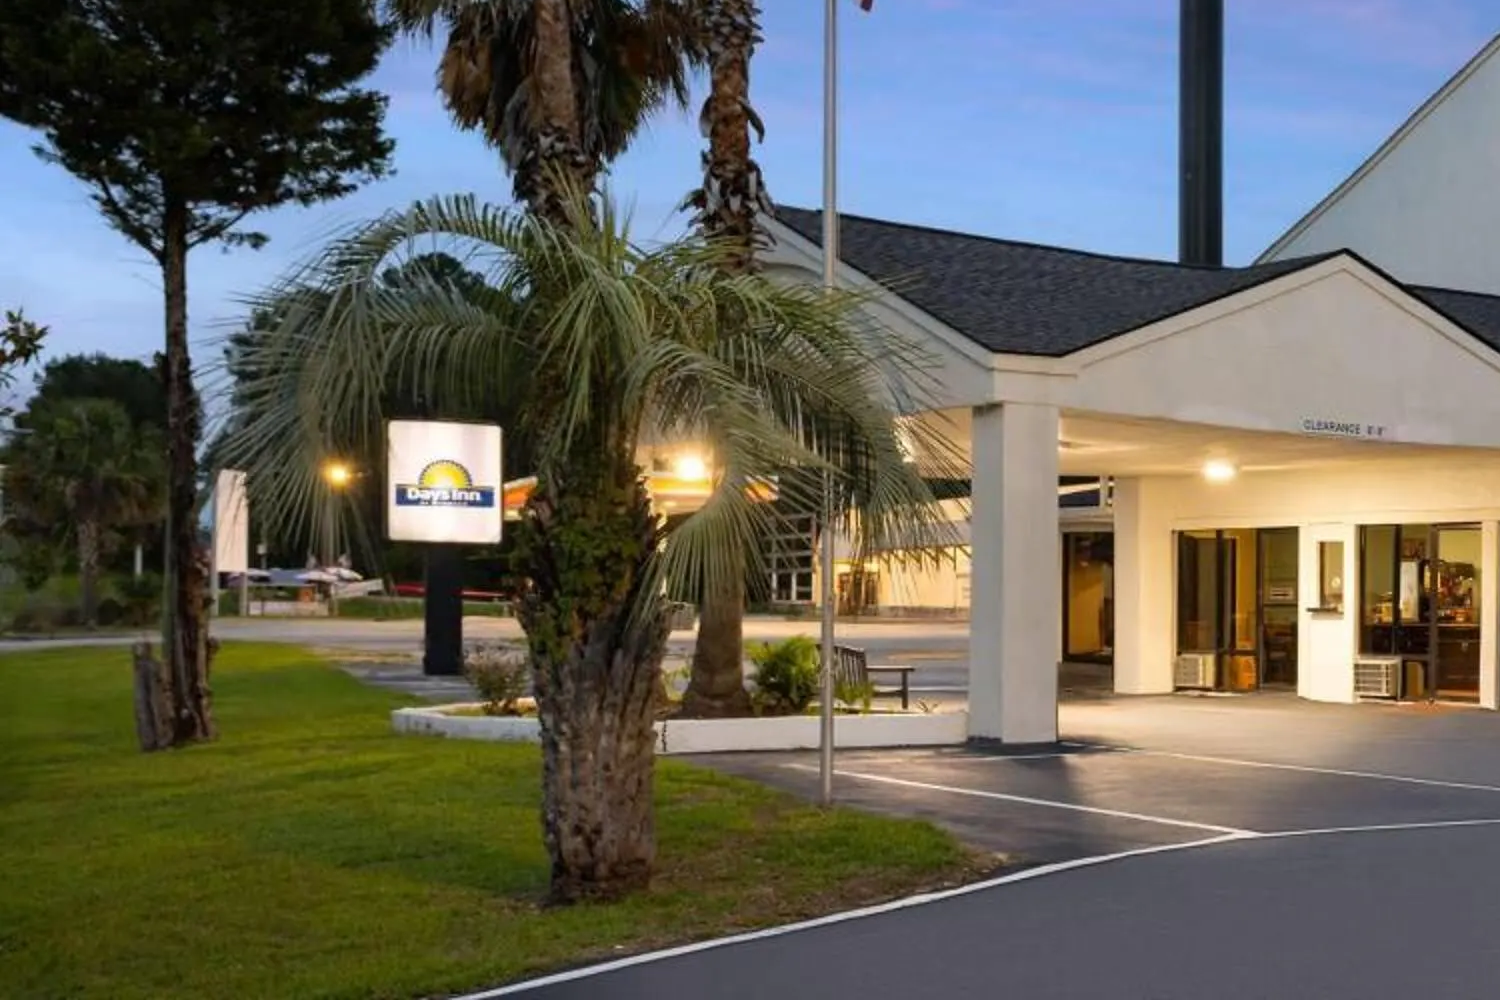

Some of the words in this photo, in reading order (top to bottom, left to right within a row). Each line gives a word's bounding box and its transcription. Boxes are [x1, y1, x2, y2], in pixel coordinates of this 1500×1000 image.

[1304, 419, 1361, 434] CLEARANCE
[407, 488, 450, 502] Days
[452, 490, 481, 501] Inn
